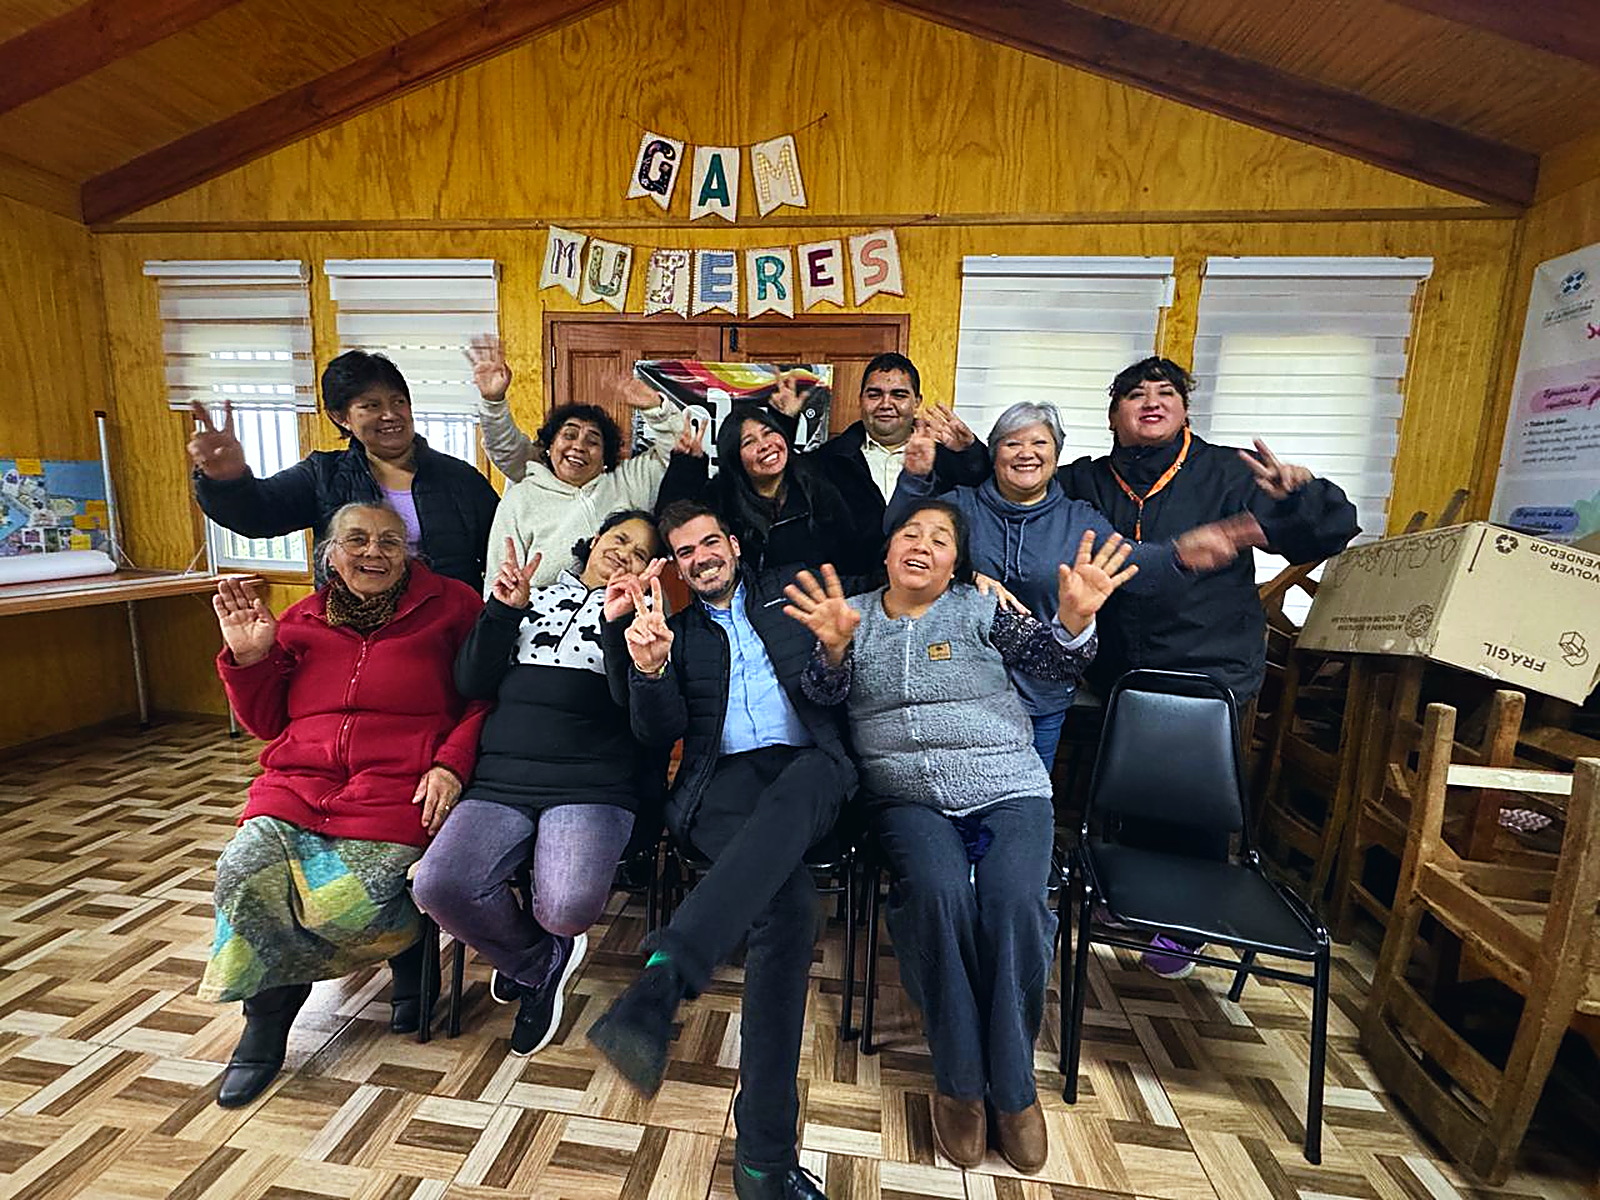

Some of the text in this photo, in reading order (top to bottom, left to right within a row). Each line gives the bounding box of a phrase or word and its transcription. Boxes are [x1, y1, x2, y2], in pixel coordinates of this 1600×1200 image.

[638, 140, 799, 207] GAM
[552, 238, 889, 305] MUJERES
[1530, 542, 1600, 570] VENDEDOR
[1549, 561, 1600, 583] VOLVER
[1483, 642, 1546, 672] FRÁGIL
